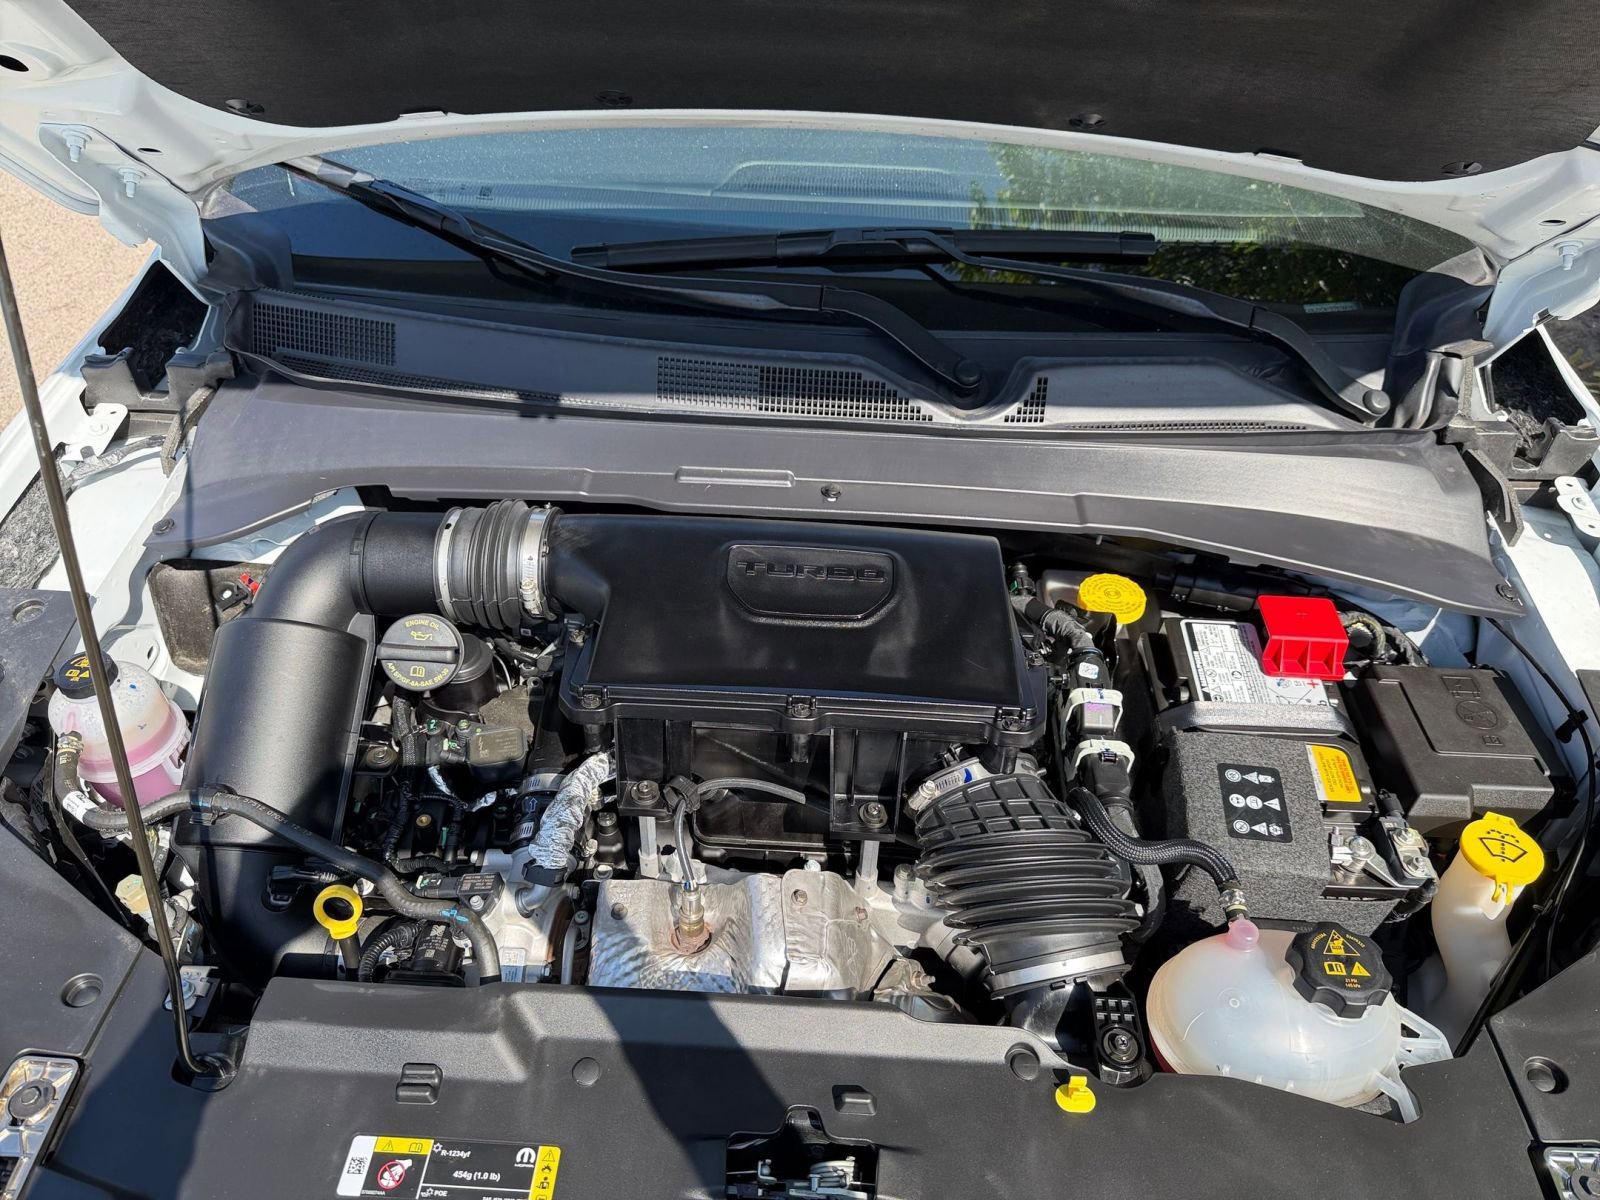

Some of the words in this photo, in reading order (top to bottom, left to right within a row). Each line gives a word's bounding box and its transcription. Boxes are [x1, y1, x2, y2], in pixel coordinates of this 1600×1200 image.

[736, 561, 887, 583] TURBO
[405, 619, 429, 628] ENGINE
[430, 621, 440, 631] OIL
[440, 1149, 471, 1159] R-1234yf
[452, 1170, 473, 1181] 454g
[473, 1171, 489, 1180] (1.0
[489, 1173, 501, 1182] lb)
